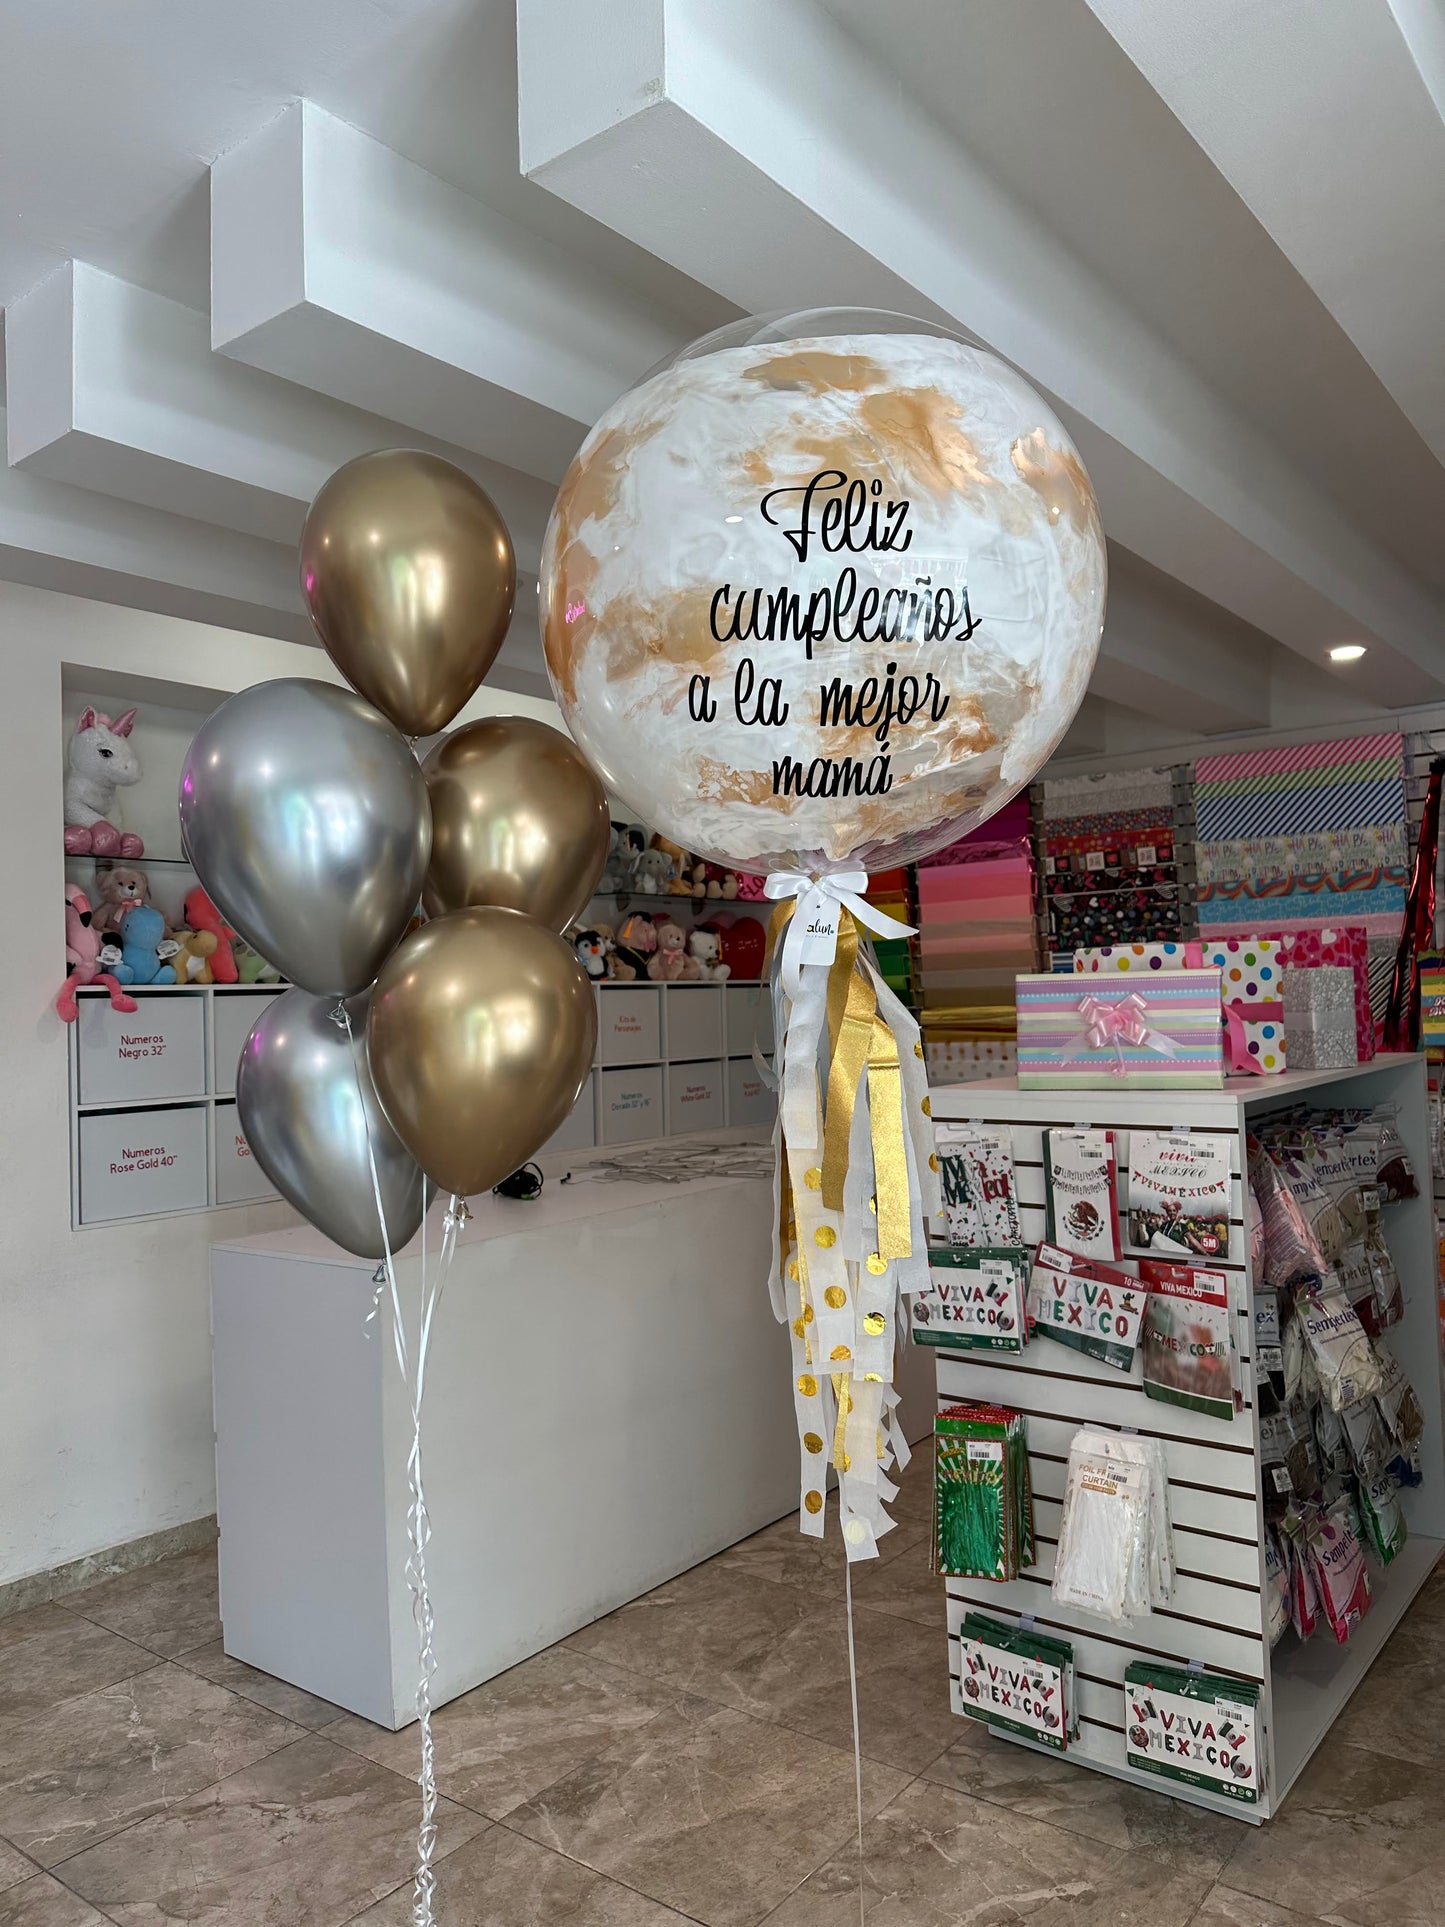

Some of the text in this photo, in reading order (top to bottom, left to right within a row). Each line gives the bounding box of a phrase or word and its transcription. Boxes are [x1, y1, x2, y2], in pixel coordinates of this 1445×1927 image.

[760, 470, 913, 562] Feliz
[709, 567, 982, 660] cumpleaños
[688, 658, 950, 741] a la mejor
[772, 742, 893, 798] mamá
[120, 1034, 164, 1046] Numeros
[118, 1047, 149, 1059] Negro
[121, 1146, 166, 1160] Numeros
[109, 1163, 135, 1175] Rose
[136, 1159, 159, 1171] Gold
[1203, 1237, 1217, 1247] 5M
[1053, 1275, 1113, 1310] VIVA
[1123, 1276, 1132, 1287] 10
[1160, 1281, 1203, 1298] VIVA MEXICO
[938, 1284, 984, 1303] VIVA
[929, 1303, 997, 1325] MEXICO
[1039, 1297, 1129, 1338] MEXICO
[1306, 1307, 1358, 1335] Sempertex
[1162, 1335, 1205, 1356] MEXCO
[1079, 1463, 1096, 1475] FOIL
[1082, 1474, 1119, 1490] CURTAIN
[987, 1663, 1031, 1693] VIVA
[980, 1681, 1042, 1718] MEXICO
[1160, 1709, 1216, 1741] VIVA
[1149, 1729, 1230, 1769] MEXICO
